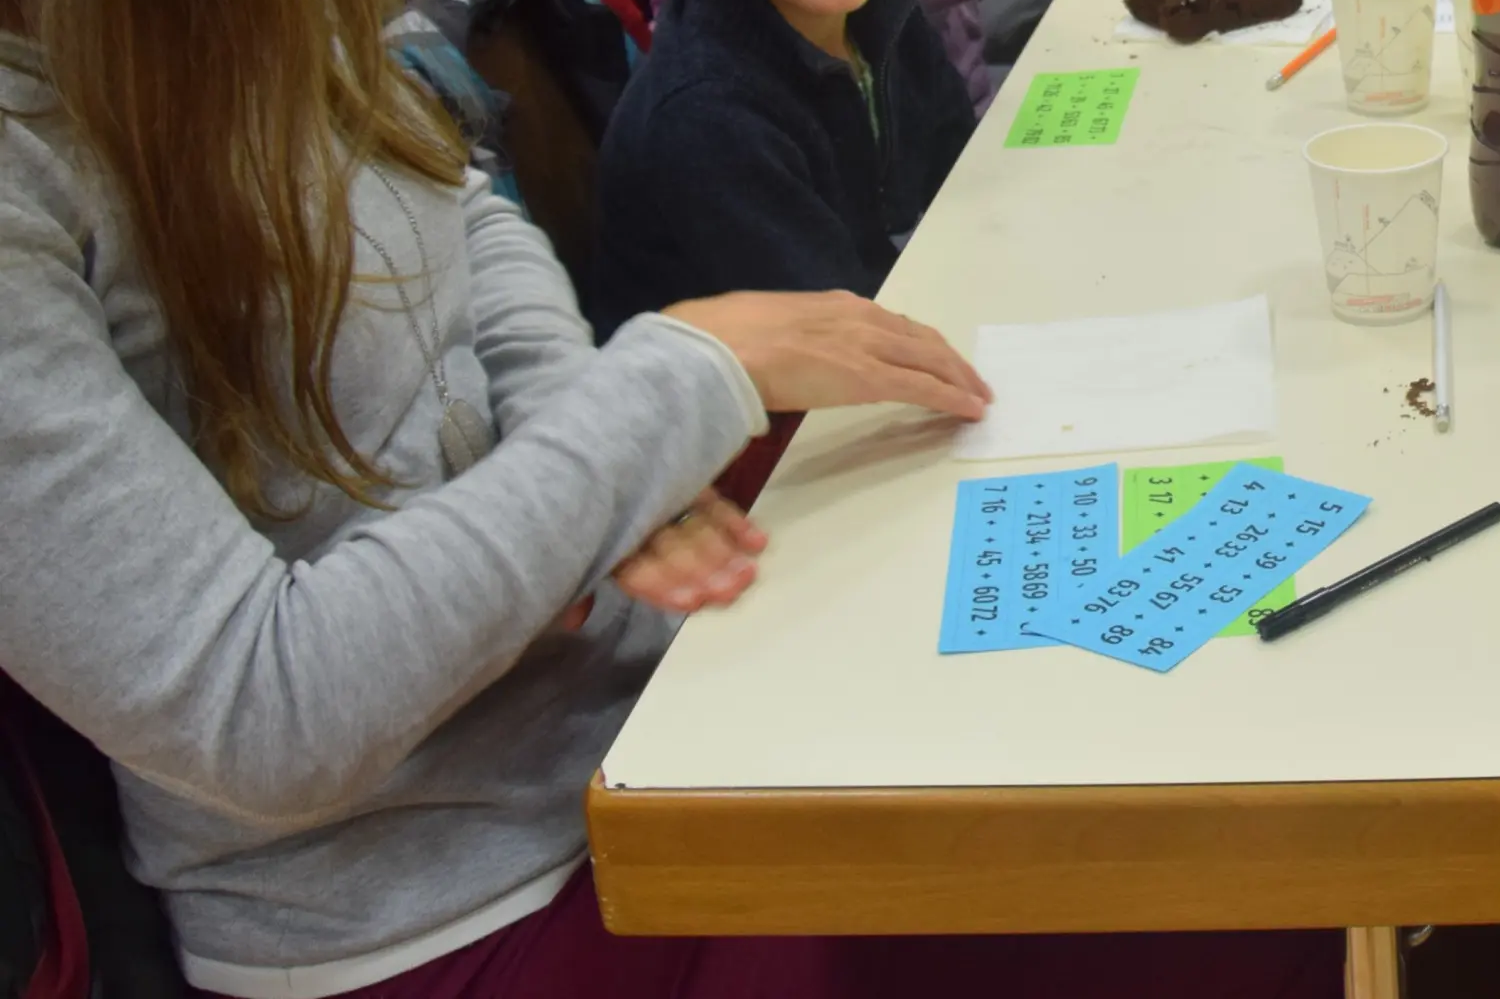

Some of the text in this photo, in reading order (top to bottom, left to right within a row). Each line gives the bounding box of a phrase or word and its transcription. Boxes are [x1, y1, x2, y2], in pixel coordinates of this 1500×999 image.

[1148, 477, 1173, 504] 3 17
[1243, 481, 1266, 491] 4
[981, 499, 1007, 513] 16
[1219, 499, 1249, 515] 13
[1071, 477, 1098, 576] 9 10 33 50
[976, 550, 1003, 566] 45
[1137, 500, 1344, 655] 5 15 39 53 84
[1100, 624, 1134, 645] 89
